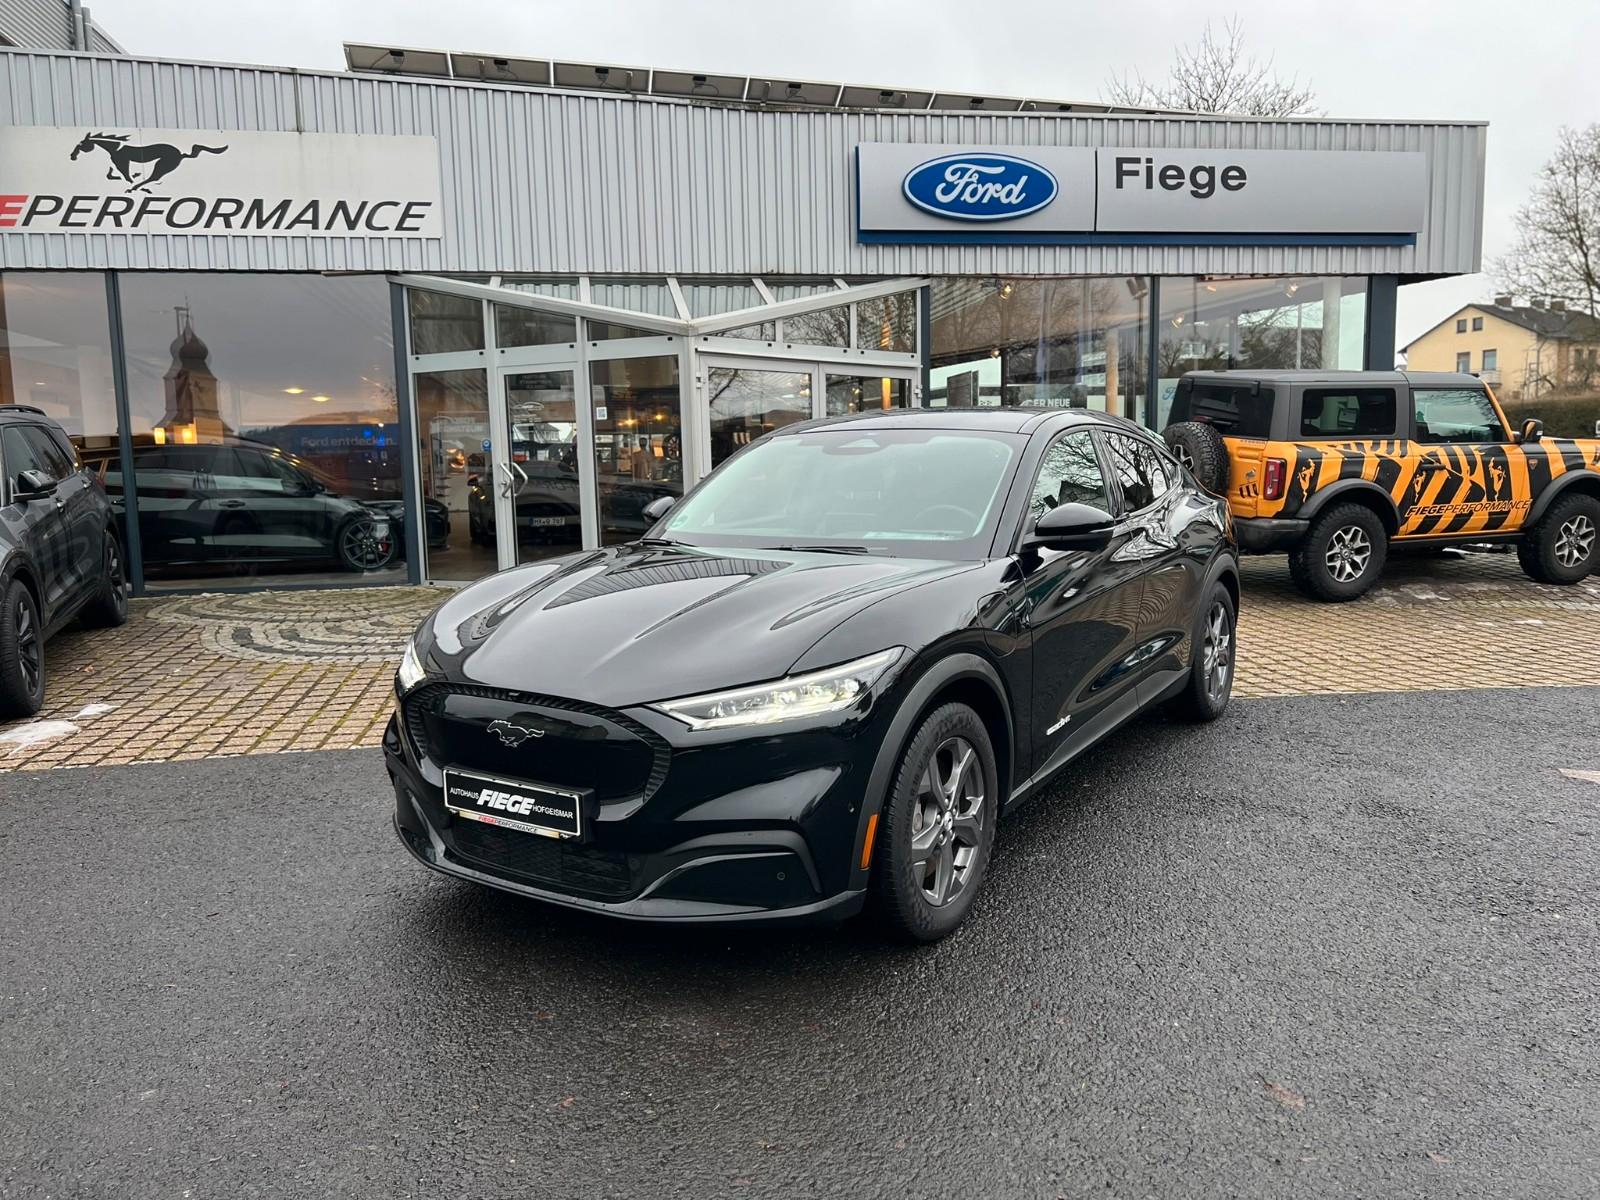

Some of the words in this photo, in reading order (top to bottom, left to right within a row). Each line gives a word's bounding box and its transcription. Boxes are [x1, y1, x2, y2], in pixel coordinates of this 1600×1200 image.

[934, 162, 1030, 206] Ford
[1115, 156, 1248, 199] Fiege
[1047, 399, 1071, 408] NEUE
[302, 436, 329, 447] Ford
[1405, 499, 1533, 517] FIEGEPERFORMANCE
[449, 787, 479, 799] AUTOHAUS
[477, 789, 535, 815] FIEGE
[532, 805, 574, 819] HOFGEISMAR
